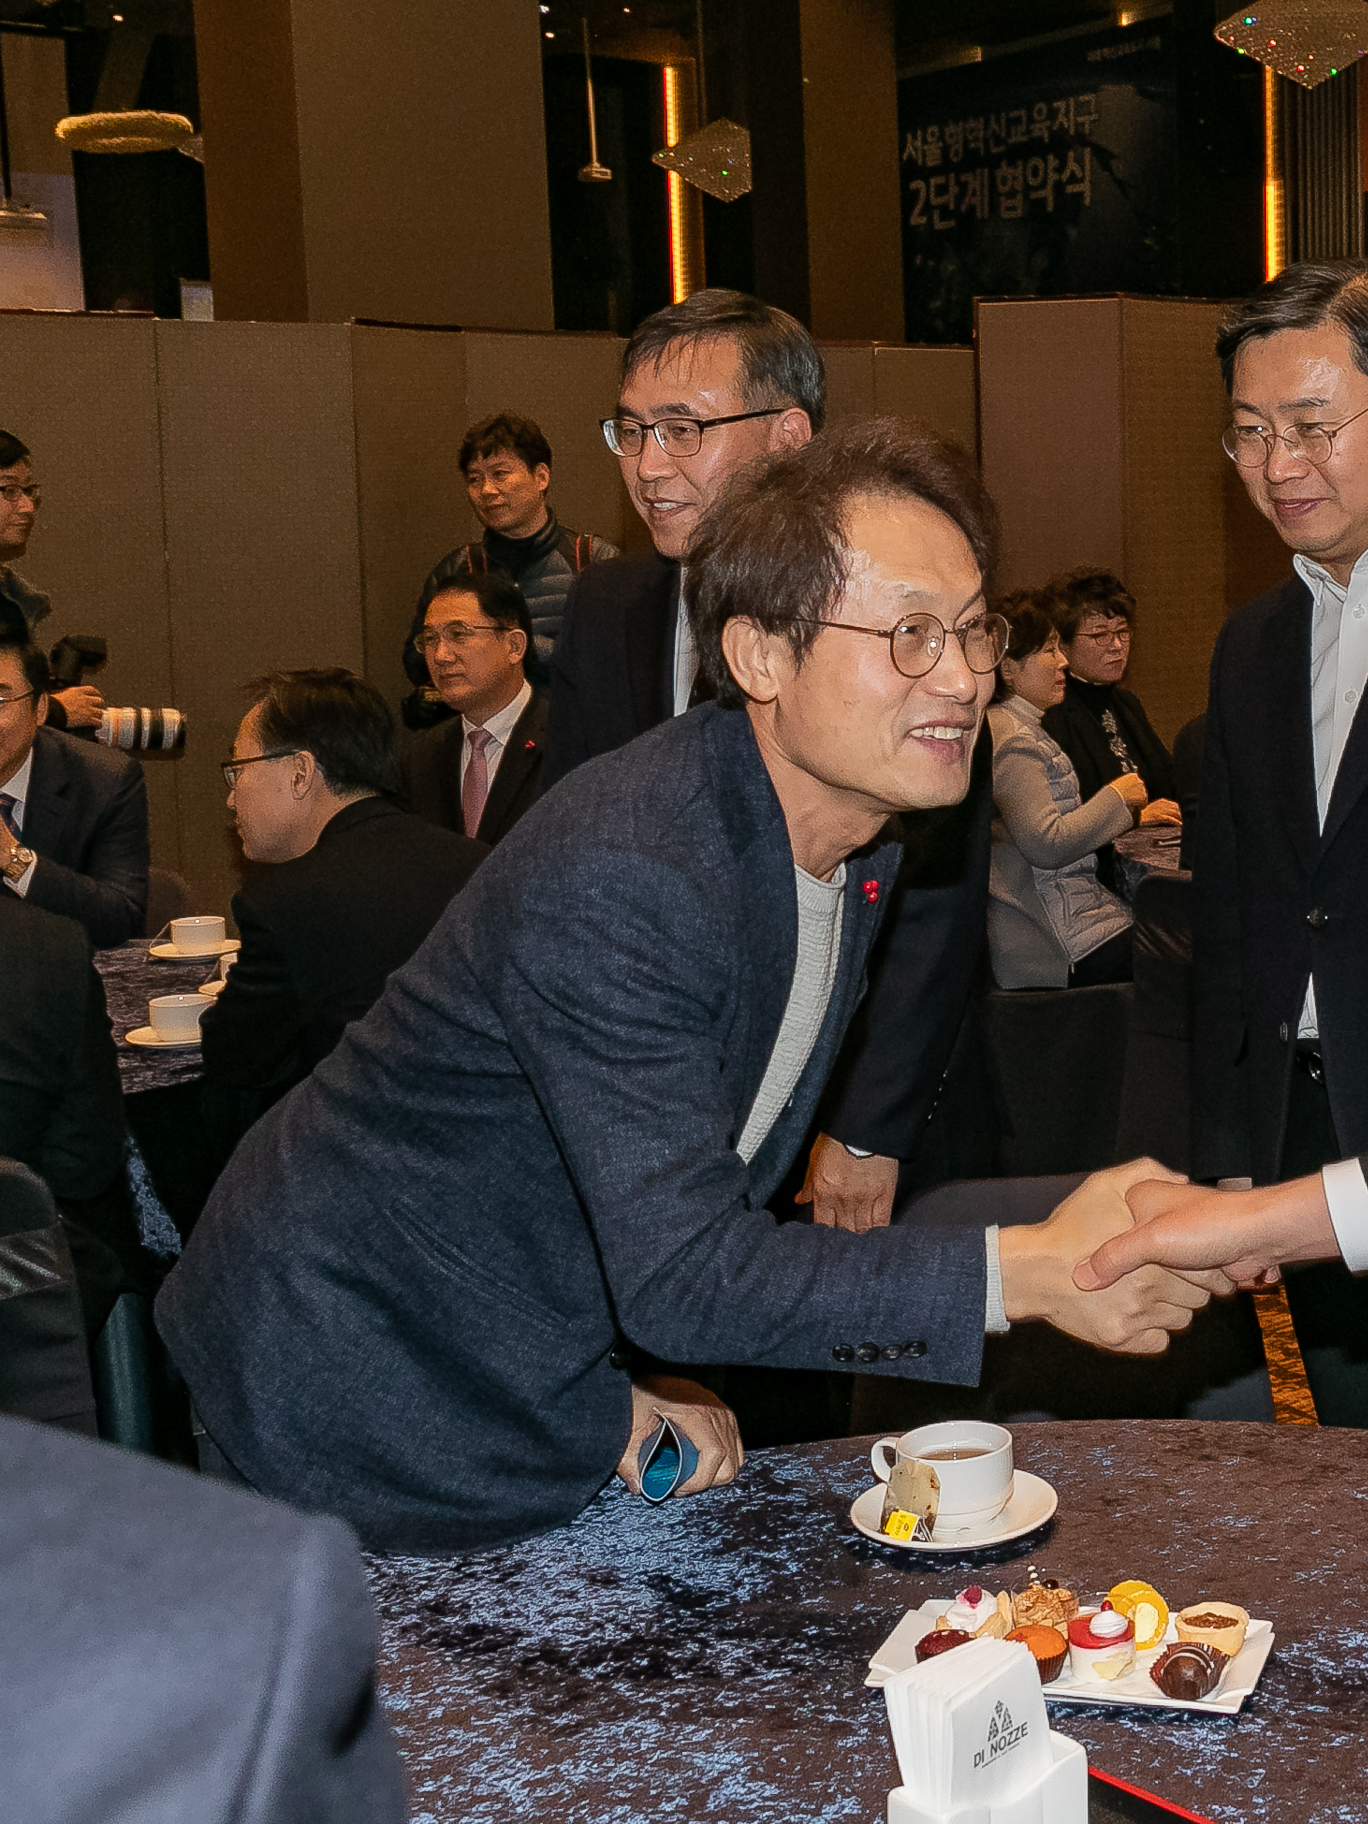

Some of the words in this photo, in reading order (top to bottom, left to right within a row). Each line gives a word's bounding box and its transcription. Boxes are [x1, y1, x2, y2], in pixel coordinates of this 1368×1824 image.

[908, 168, 990, 230] 2단계
[996, 148, 1092, 219] 협약식
[973, 1748, 985, 1768] DI
[990, 1722, 1028, 1757] NOZZE
